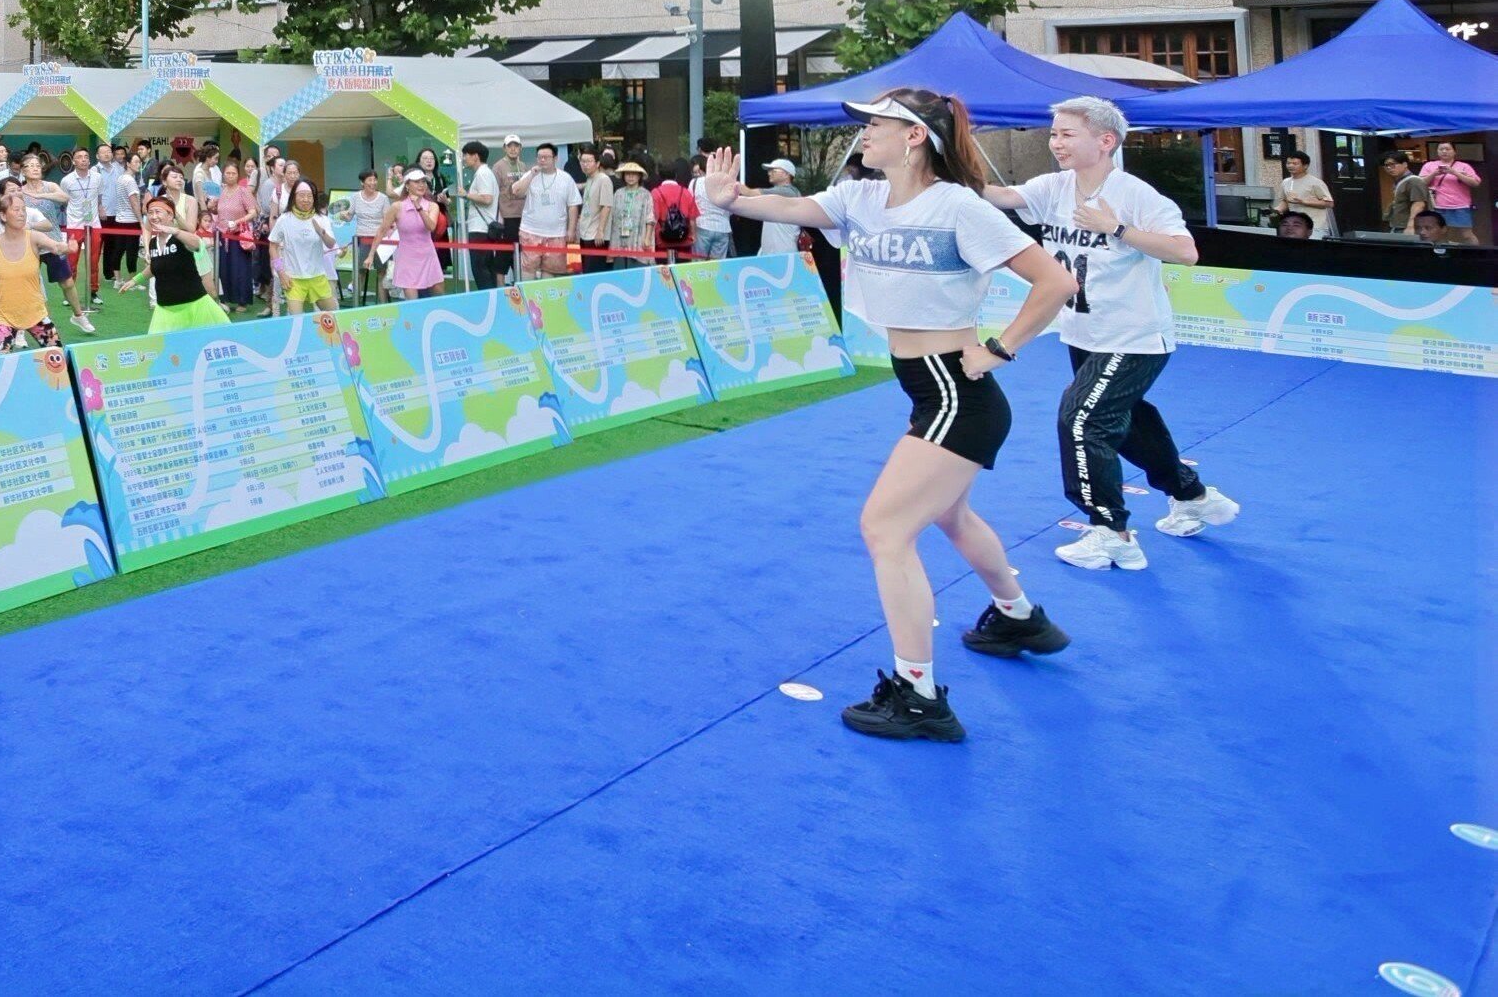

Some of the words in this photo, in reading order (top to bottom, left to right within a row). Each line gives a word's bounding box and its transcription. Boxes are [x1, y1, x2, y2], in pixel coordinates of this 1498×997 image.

[323, 65, 394, 76] 全民健身日开幕式
[1042, 224, 1108, 249] ZUMBA
[204, 345, 239, 362] 区体育局
[1102, 353, 1125, 376] UMBA
[1084, 378, 1110, 410] ZUMBA
[1073, 409, 1090, 442] ZUMBA
[1075, 445, 1089, 480] ZUMBA
